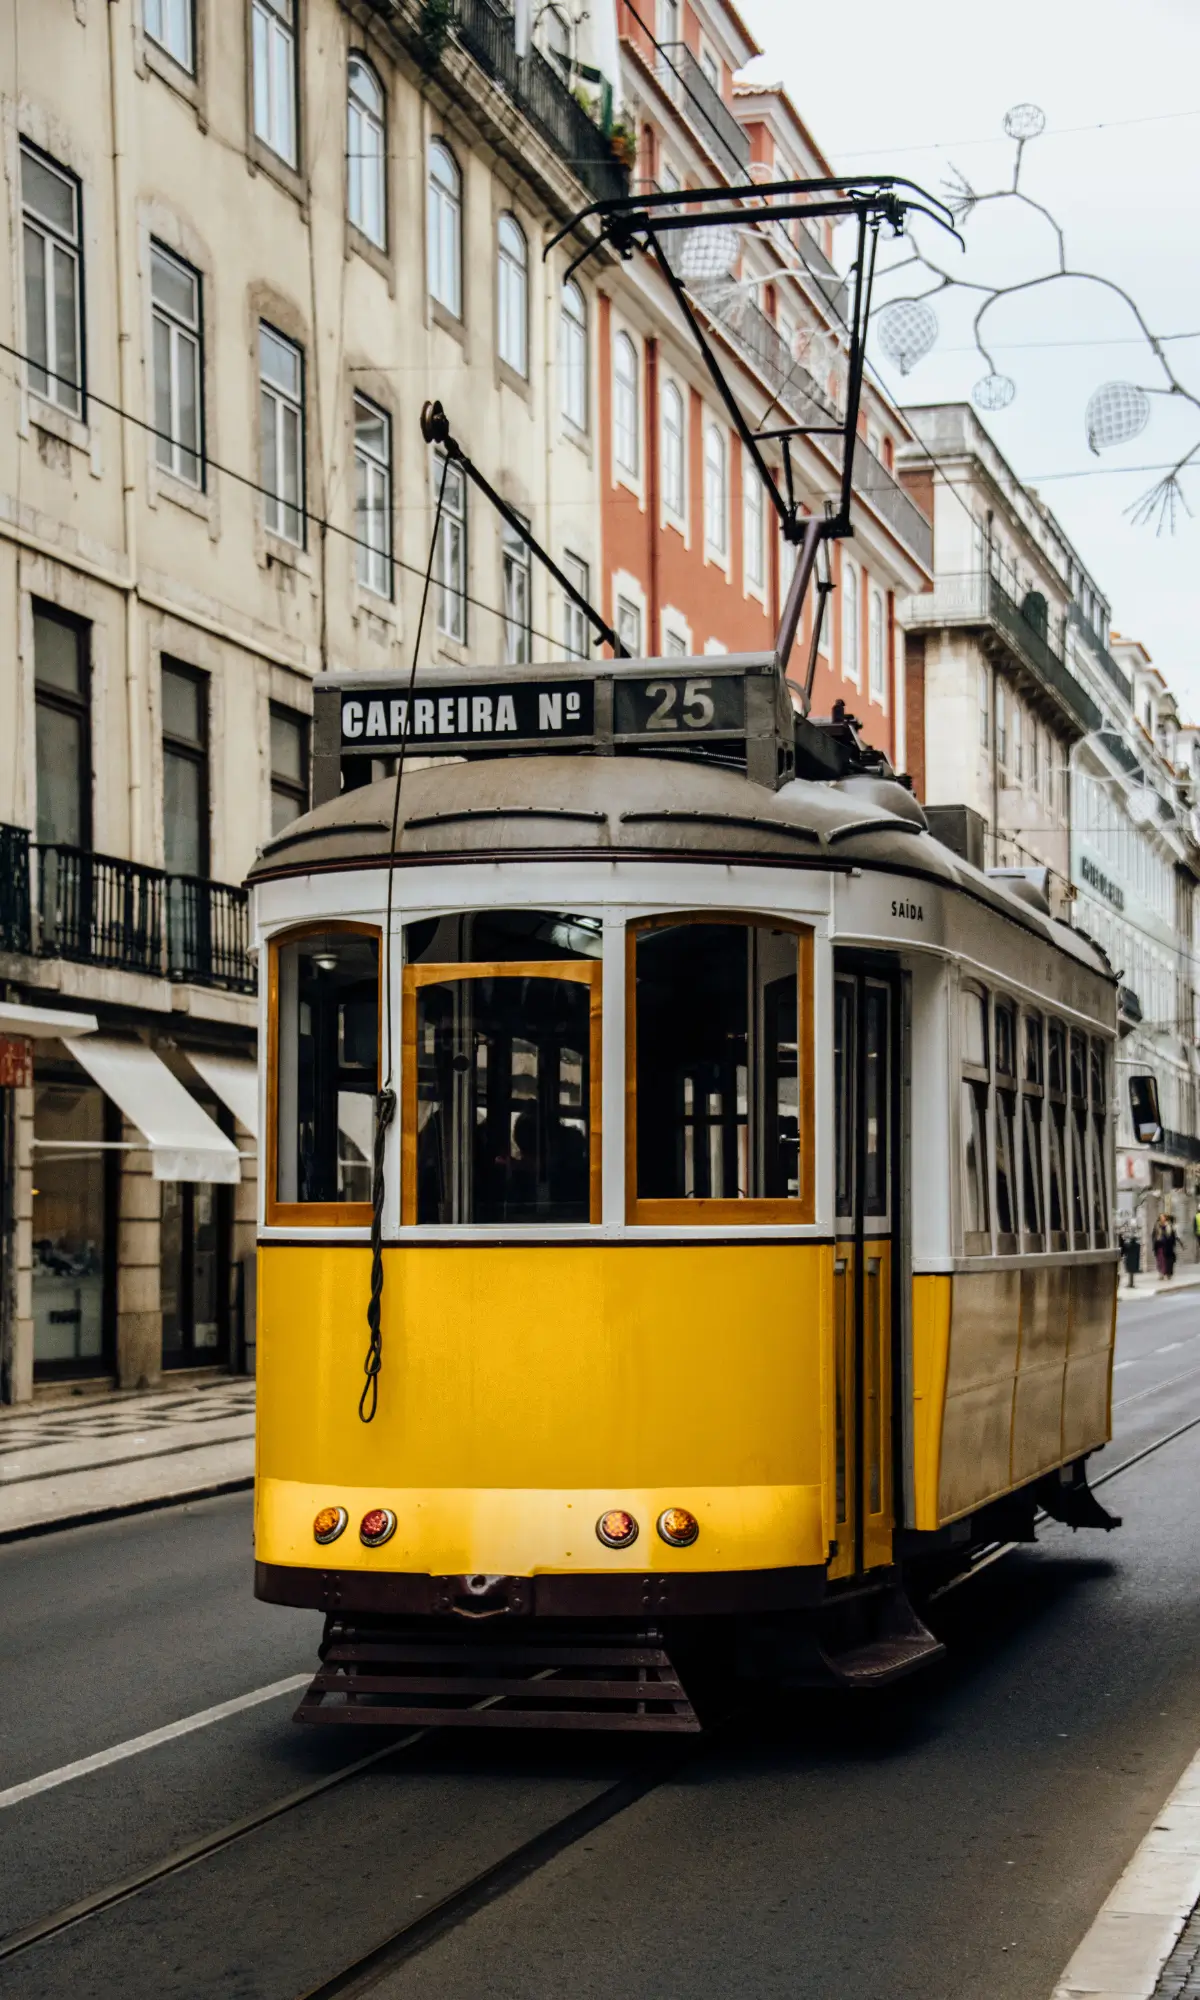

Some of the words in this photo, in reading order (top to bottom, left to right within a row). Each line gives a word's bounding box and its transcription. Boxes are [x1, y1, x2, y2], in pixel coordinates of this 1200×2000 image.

[342, 695, 518, 738] CARREIRA
[538, 691, 581, 731] Nº
[645, 679, 715, 730] 25
[891, 898, 924, 921] SAÍDA
